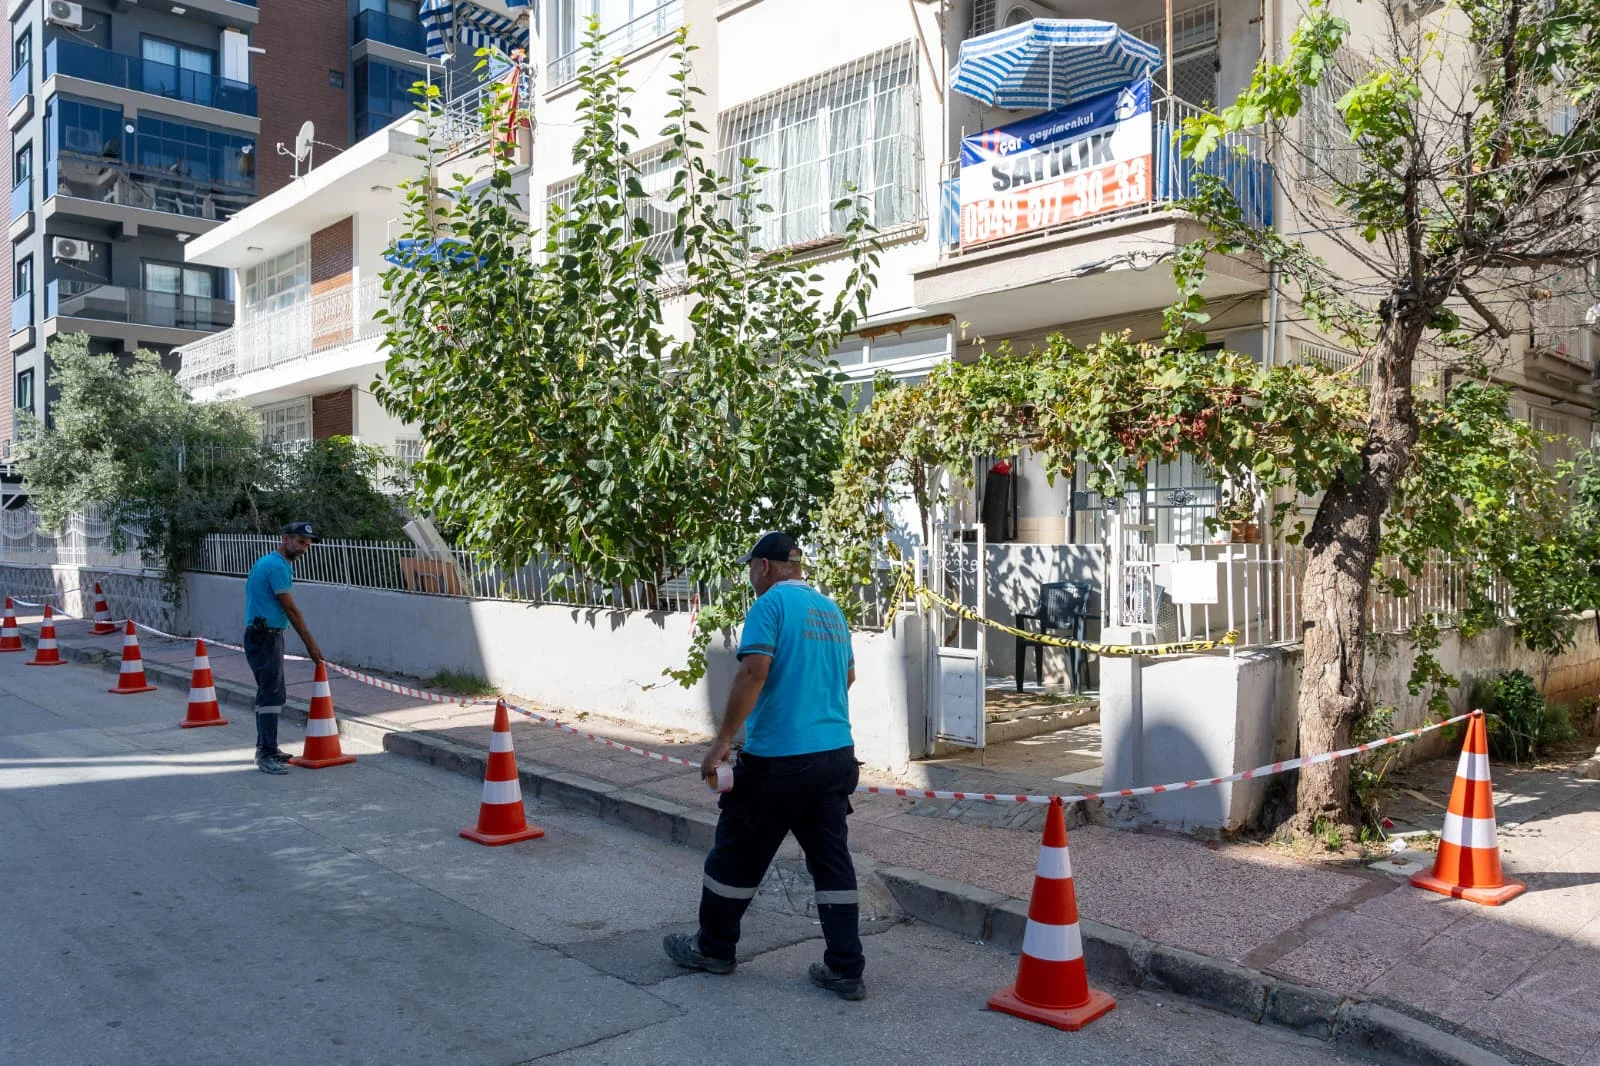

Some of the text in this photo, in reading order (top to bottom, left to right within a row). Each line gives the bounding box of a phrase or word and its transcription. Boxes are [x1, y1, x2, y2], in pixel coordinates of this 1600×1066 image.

[1029, 112, 1094, 144] gayrimenkul
[992, 130, 1115, 192] SATILIK
[964, 195, 1017, 243] 0549
[1072, 171, 1103, 217] 30
[1114, 157, 1146, 207] 33
